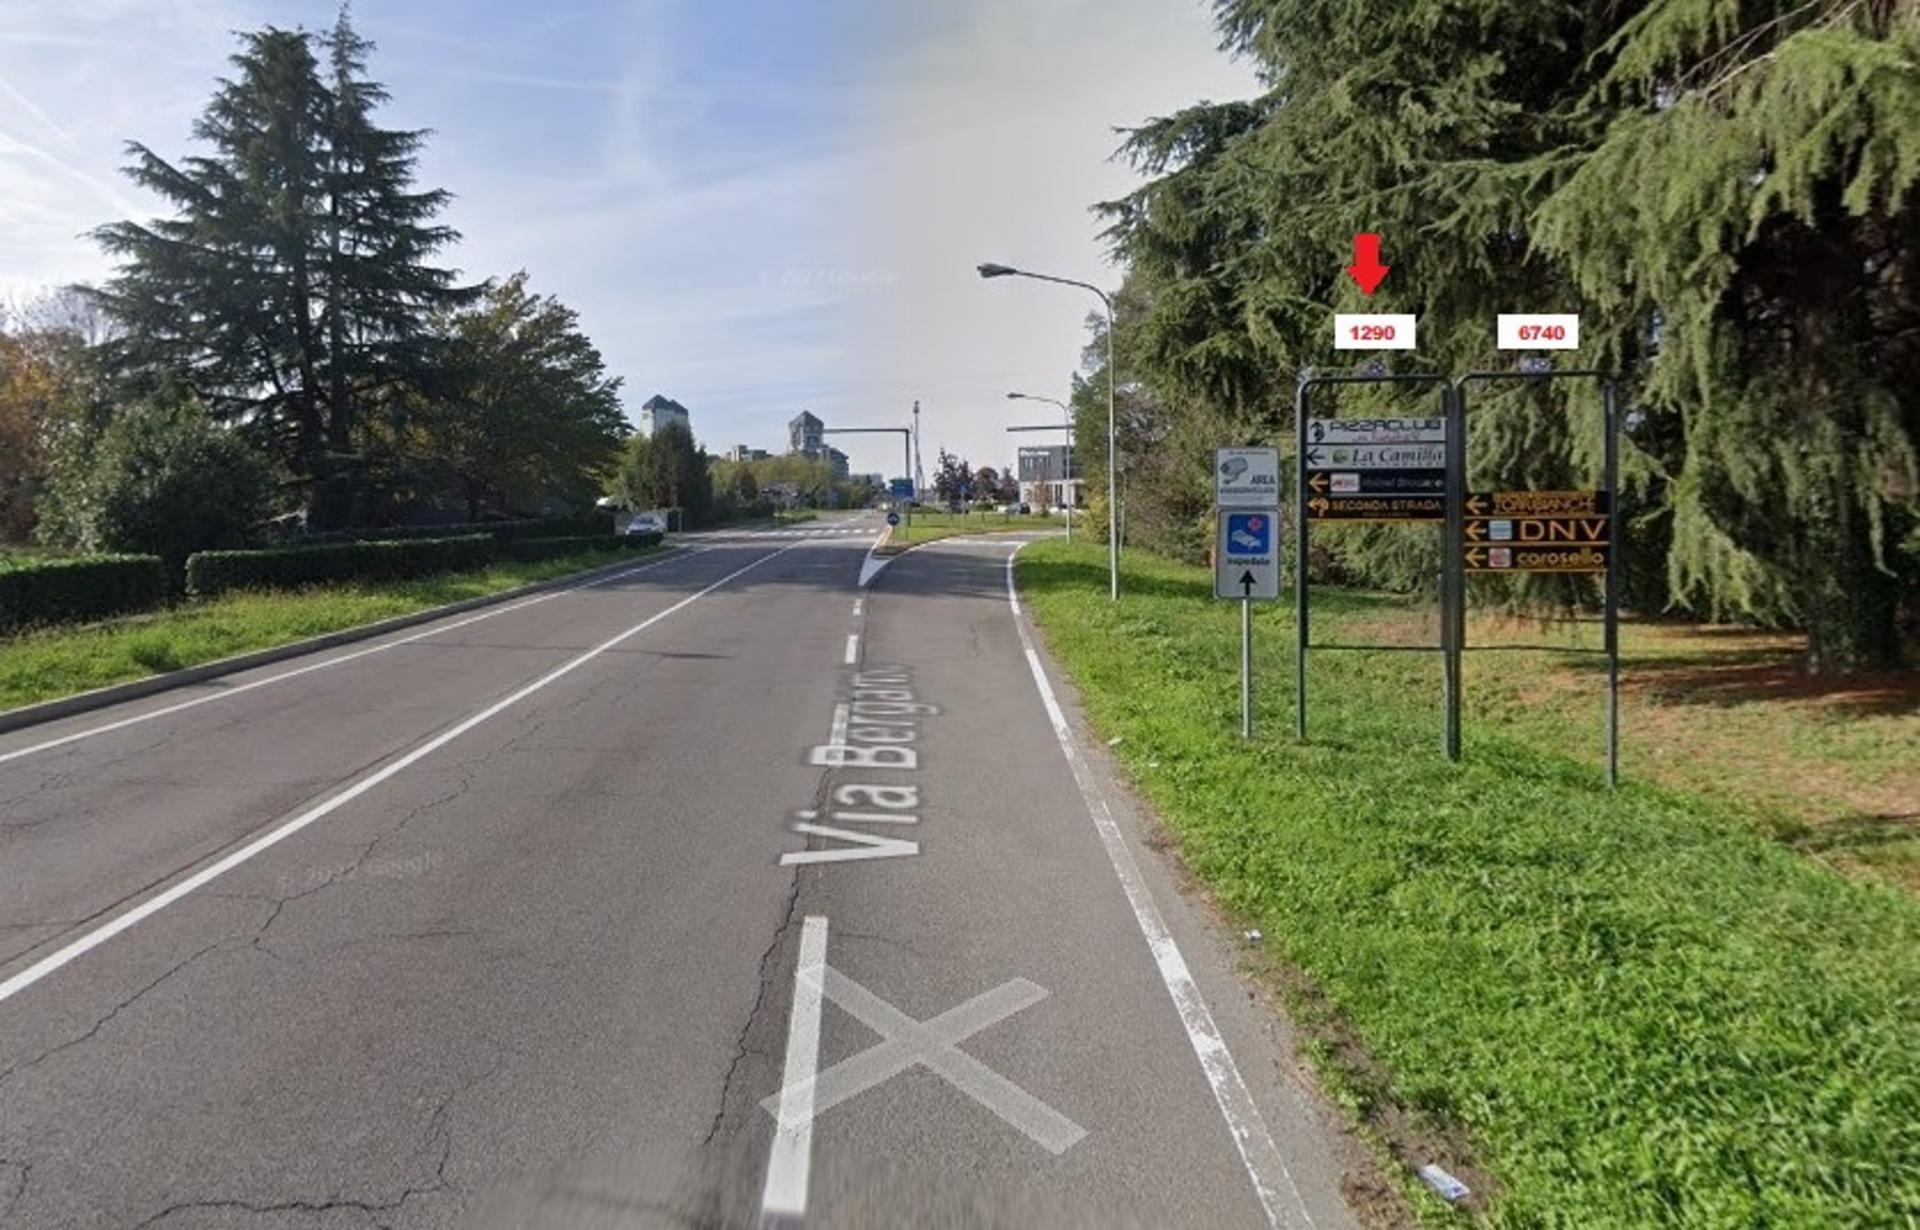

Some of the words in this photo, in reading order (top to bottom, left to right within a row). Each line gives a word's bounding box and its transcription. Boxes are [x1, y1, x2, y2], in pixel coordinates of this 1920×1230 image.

[1352, 447, 1373, 462] La
[1379, 447, 1443, 462] Camilla
[1250, 474, 1276, 485] AREA
[1331, 499, 1389, 511] SECONDA
[1391, 499, 1441, 511] STRADA
[1519, 519, 1606, 541] DNV
